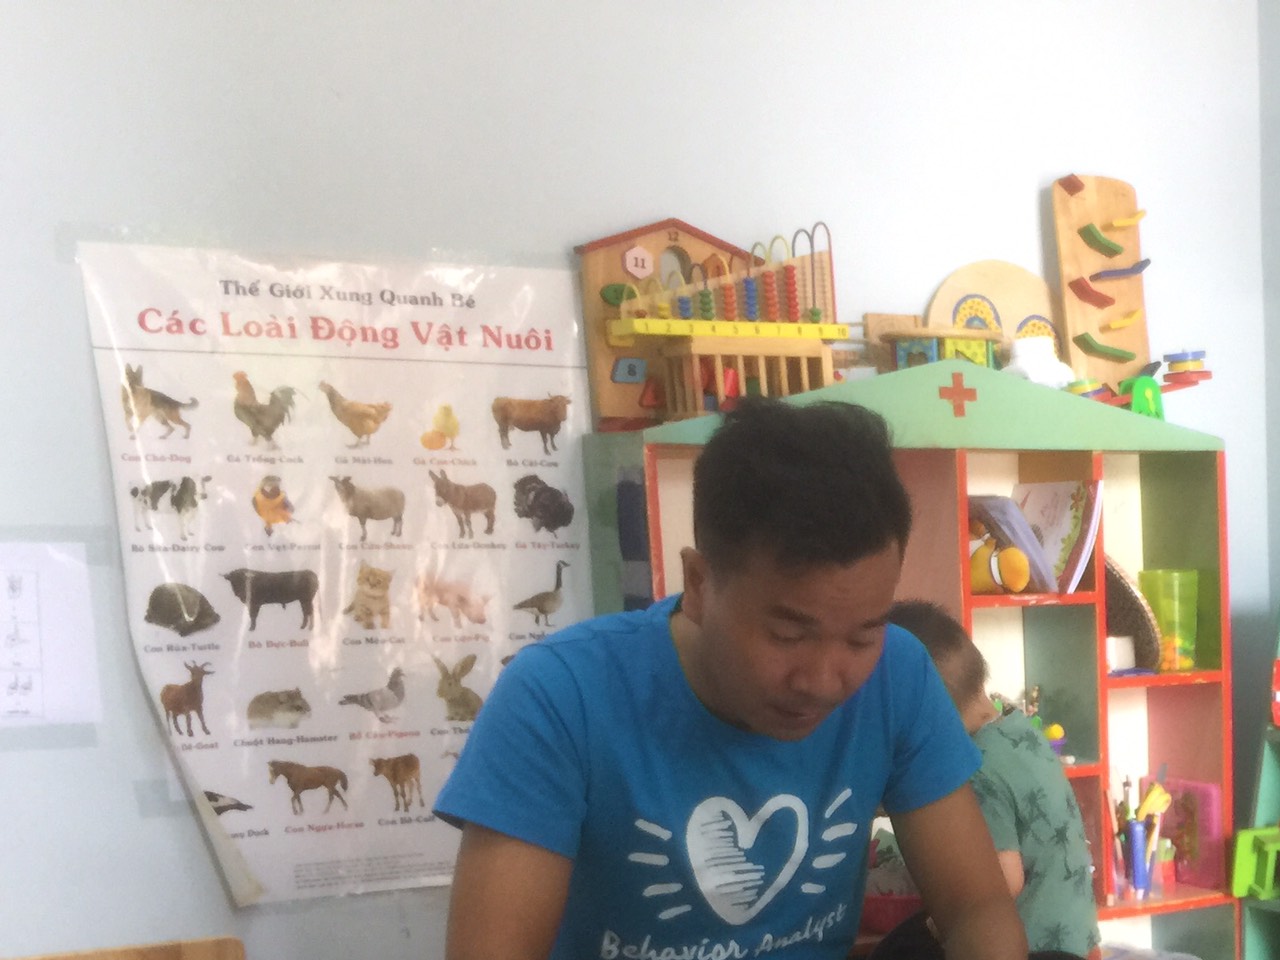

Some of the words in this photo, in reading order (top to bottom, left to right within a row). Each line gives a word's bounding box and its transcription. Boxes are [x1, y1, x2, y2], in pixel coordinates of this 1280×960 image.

[668, 231, 679, 241] 12
[633, 257, 646, 269] 11
[220, 279, 260, 297] Thế
[269, 283, 312, 299] Giới
[320, 285, 373, 305] Xung
[380, 289, 443, 306] Quanh
[451, 293, 476, 308] Bé
[138, 307, 207, 336] Các
[220, 311, 297, 339] Loài
[310, 316, 399, 350] Động
[411, 321, 467, 351] Vật
[480, 324, 553, 351] Nuôi
[247, 829, 269, 838] Duck
[754, 903, 848, 958] Analyst
